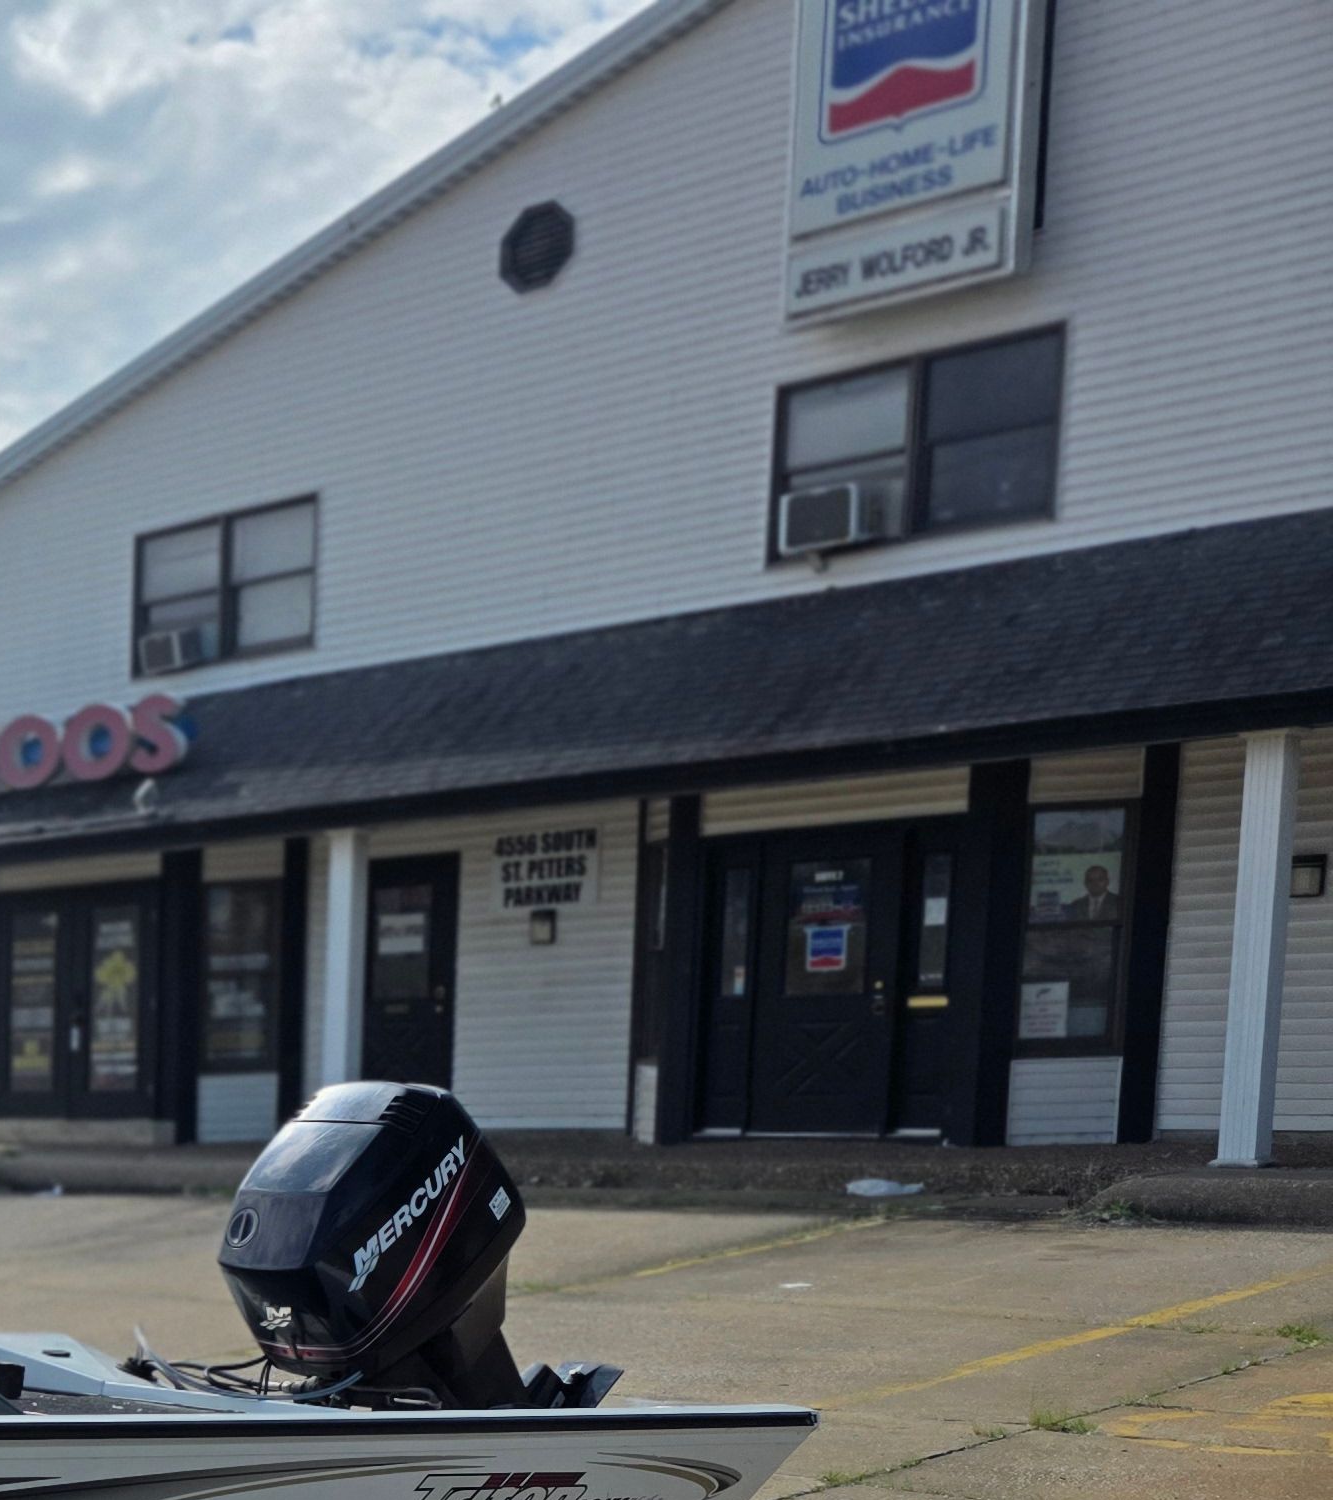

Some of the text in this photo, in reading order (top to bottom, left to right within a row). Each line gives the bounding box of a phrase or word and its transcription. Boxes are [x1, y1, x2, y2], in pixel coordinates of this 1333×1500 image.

[836, 165, 953, 215] BUSINESS
[794, 263, 851, 298] JERRY
[860, 235, 954, 281] WOLFORD
[541, 828, 597, 854] SOUTH
[527, 854, 587, 880] PETERS
[503, 881, 583, 908] PARKWAY
[348, 1135, 469, 1292] MERCURY
